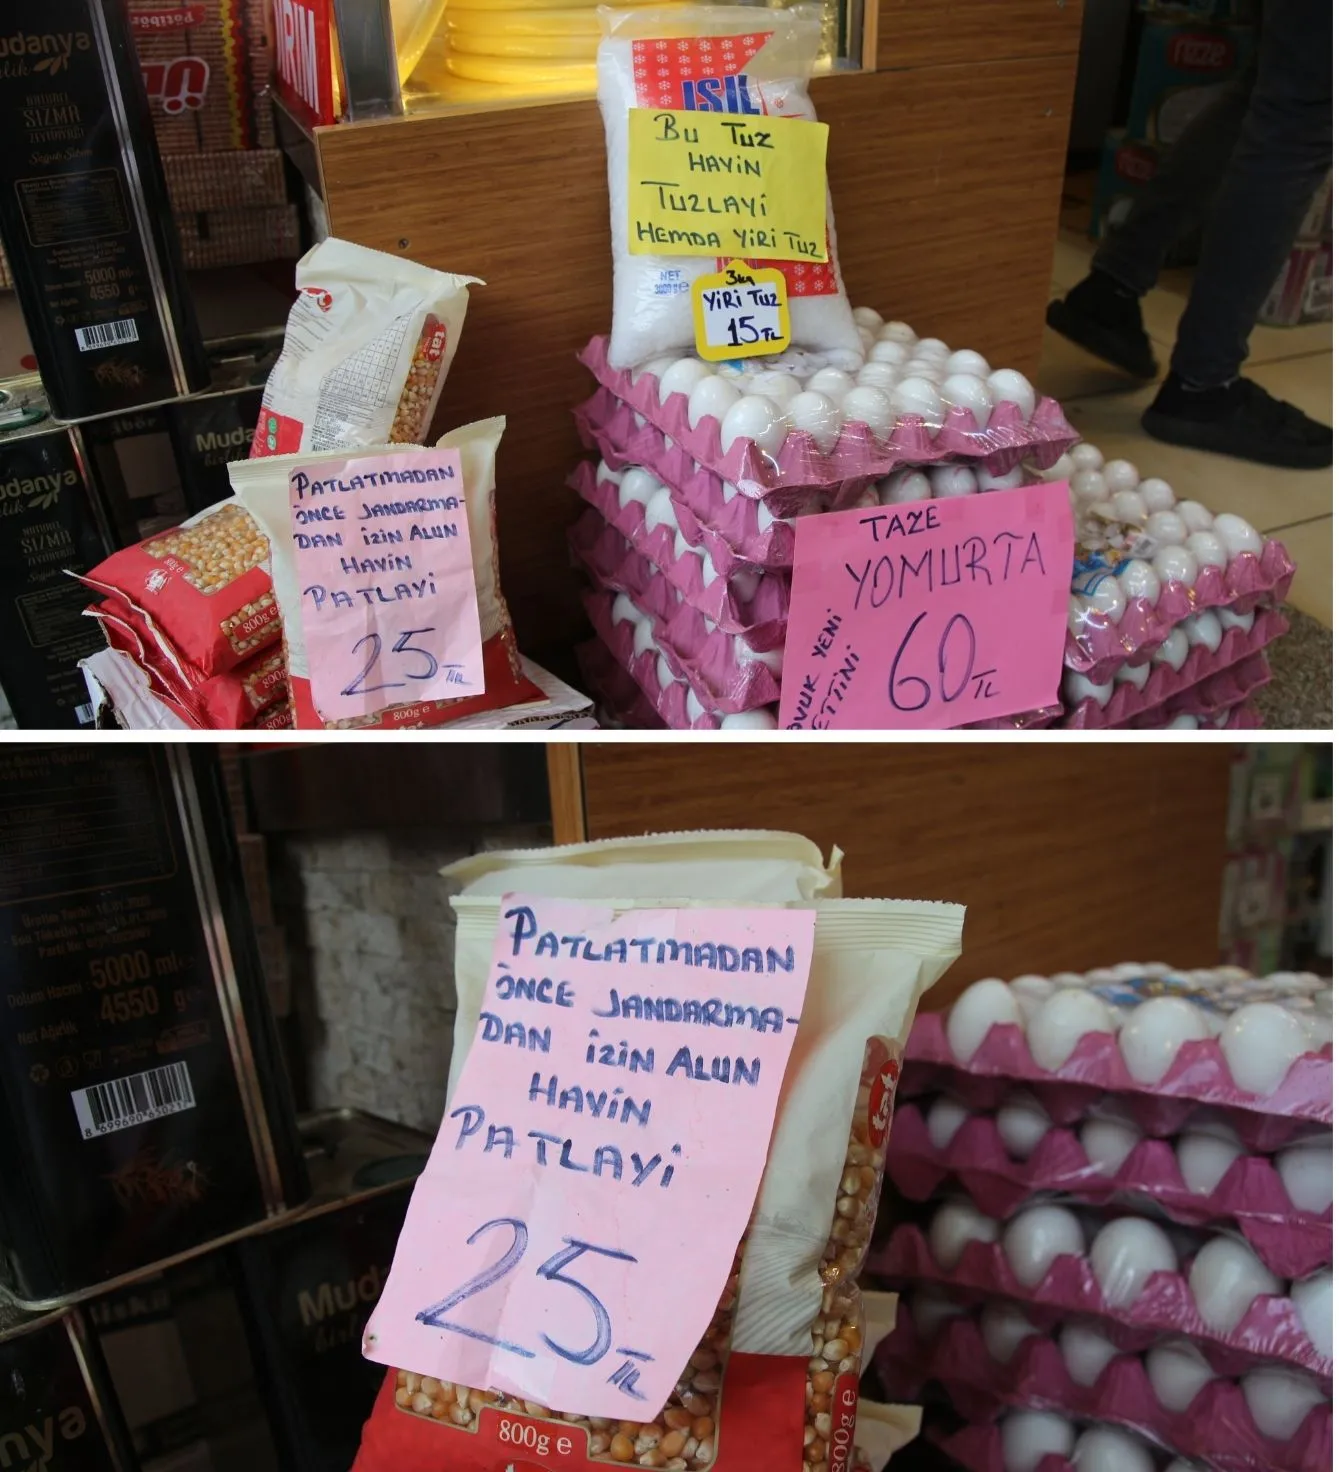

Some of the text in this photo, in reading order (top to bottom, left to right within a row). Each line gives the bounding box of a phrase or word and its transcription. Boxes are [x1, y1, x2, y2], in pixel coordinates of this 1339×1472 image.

[660, 270, 681, 281] NET
[727, 315, 785, 346] 15 TL
[292, 465, 456, 499] PATLATMADAN
[293, 531, 343, 550] DAN
[409, 523, 459, 542] ALUN
[859, 505, 941, 542] TAZE
[845, 531, 1046, 611] YOMURTA
[242, 612, 270, 634] 800g
[340, 626, 441, 698] 25
[888, 611, 1001, 713] 60 TL
[393, 706, 420, 722] 800g
[504, 905, 796, 974] PATLATMADAN
[89, 948, 151, 990] 5000
[100, 985, 161, 1025] 4550
[479, 1010, 552, 1055] DAN
[664, 1044, 762, 1087] ALUN
[415, 1217, 639, 1367] 25
[499, 1418, 573, 1457] 800g e
